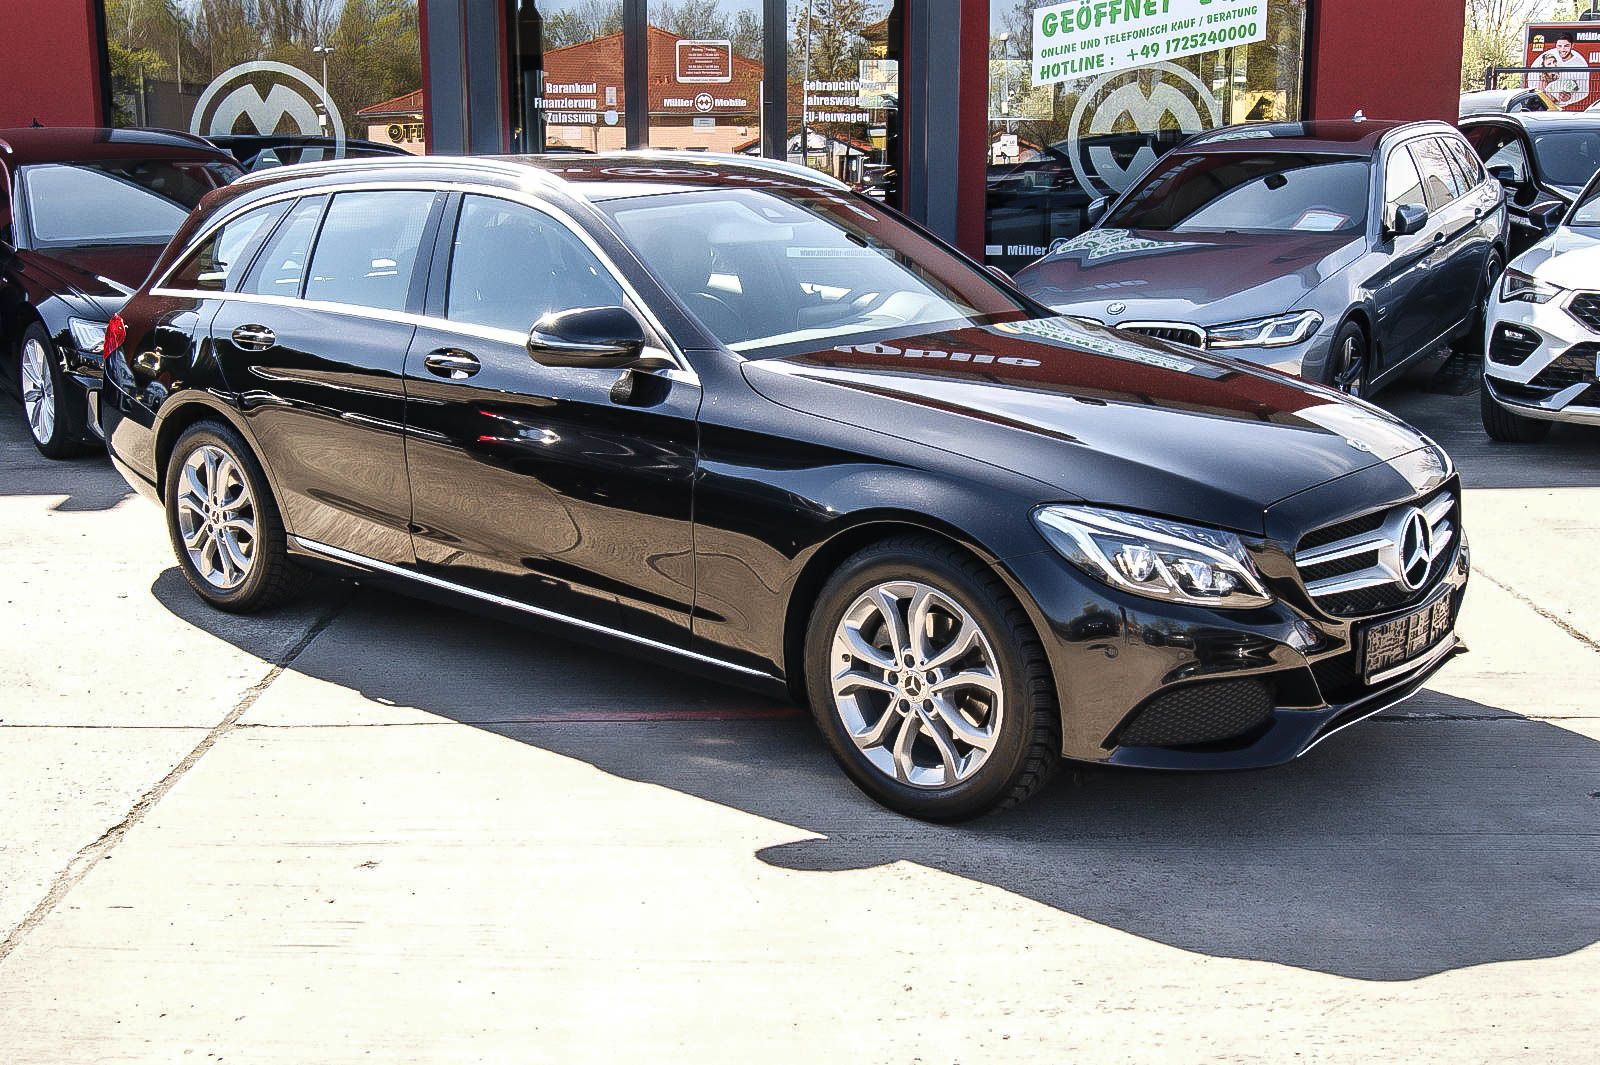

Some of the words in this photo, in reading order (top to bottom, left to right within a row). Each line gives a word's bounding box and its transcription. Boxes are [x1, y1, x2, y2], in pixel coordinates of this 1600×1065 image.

[1041, 43, 1077, 59] ONLINE
[1080, 38, 1101, 51] UND
[1104, 23, 1168, 46] TELEFONISCH
[1171, 15, 1196, 32] KAUF
[1206, 5, 1258, 25] BERATUNG
[1040, 54, 1105, 80] HOTLINE
[1126, 43, 1161, 62] +49
[1165, 22, 1258, 55] 1725240000
[546, 82, 597, 94] Barankauf
[534, 97, 597, 110] Finanzierung
[546, 112, 597, 124] Zulassung
[1007, 245, 1048, 256] Müller
